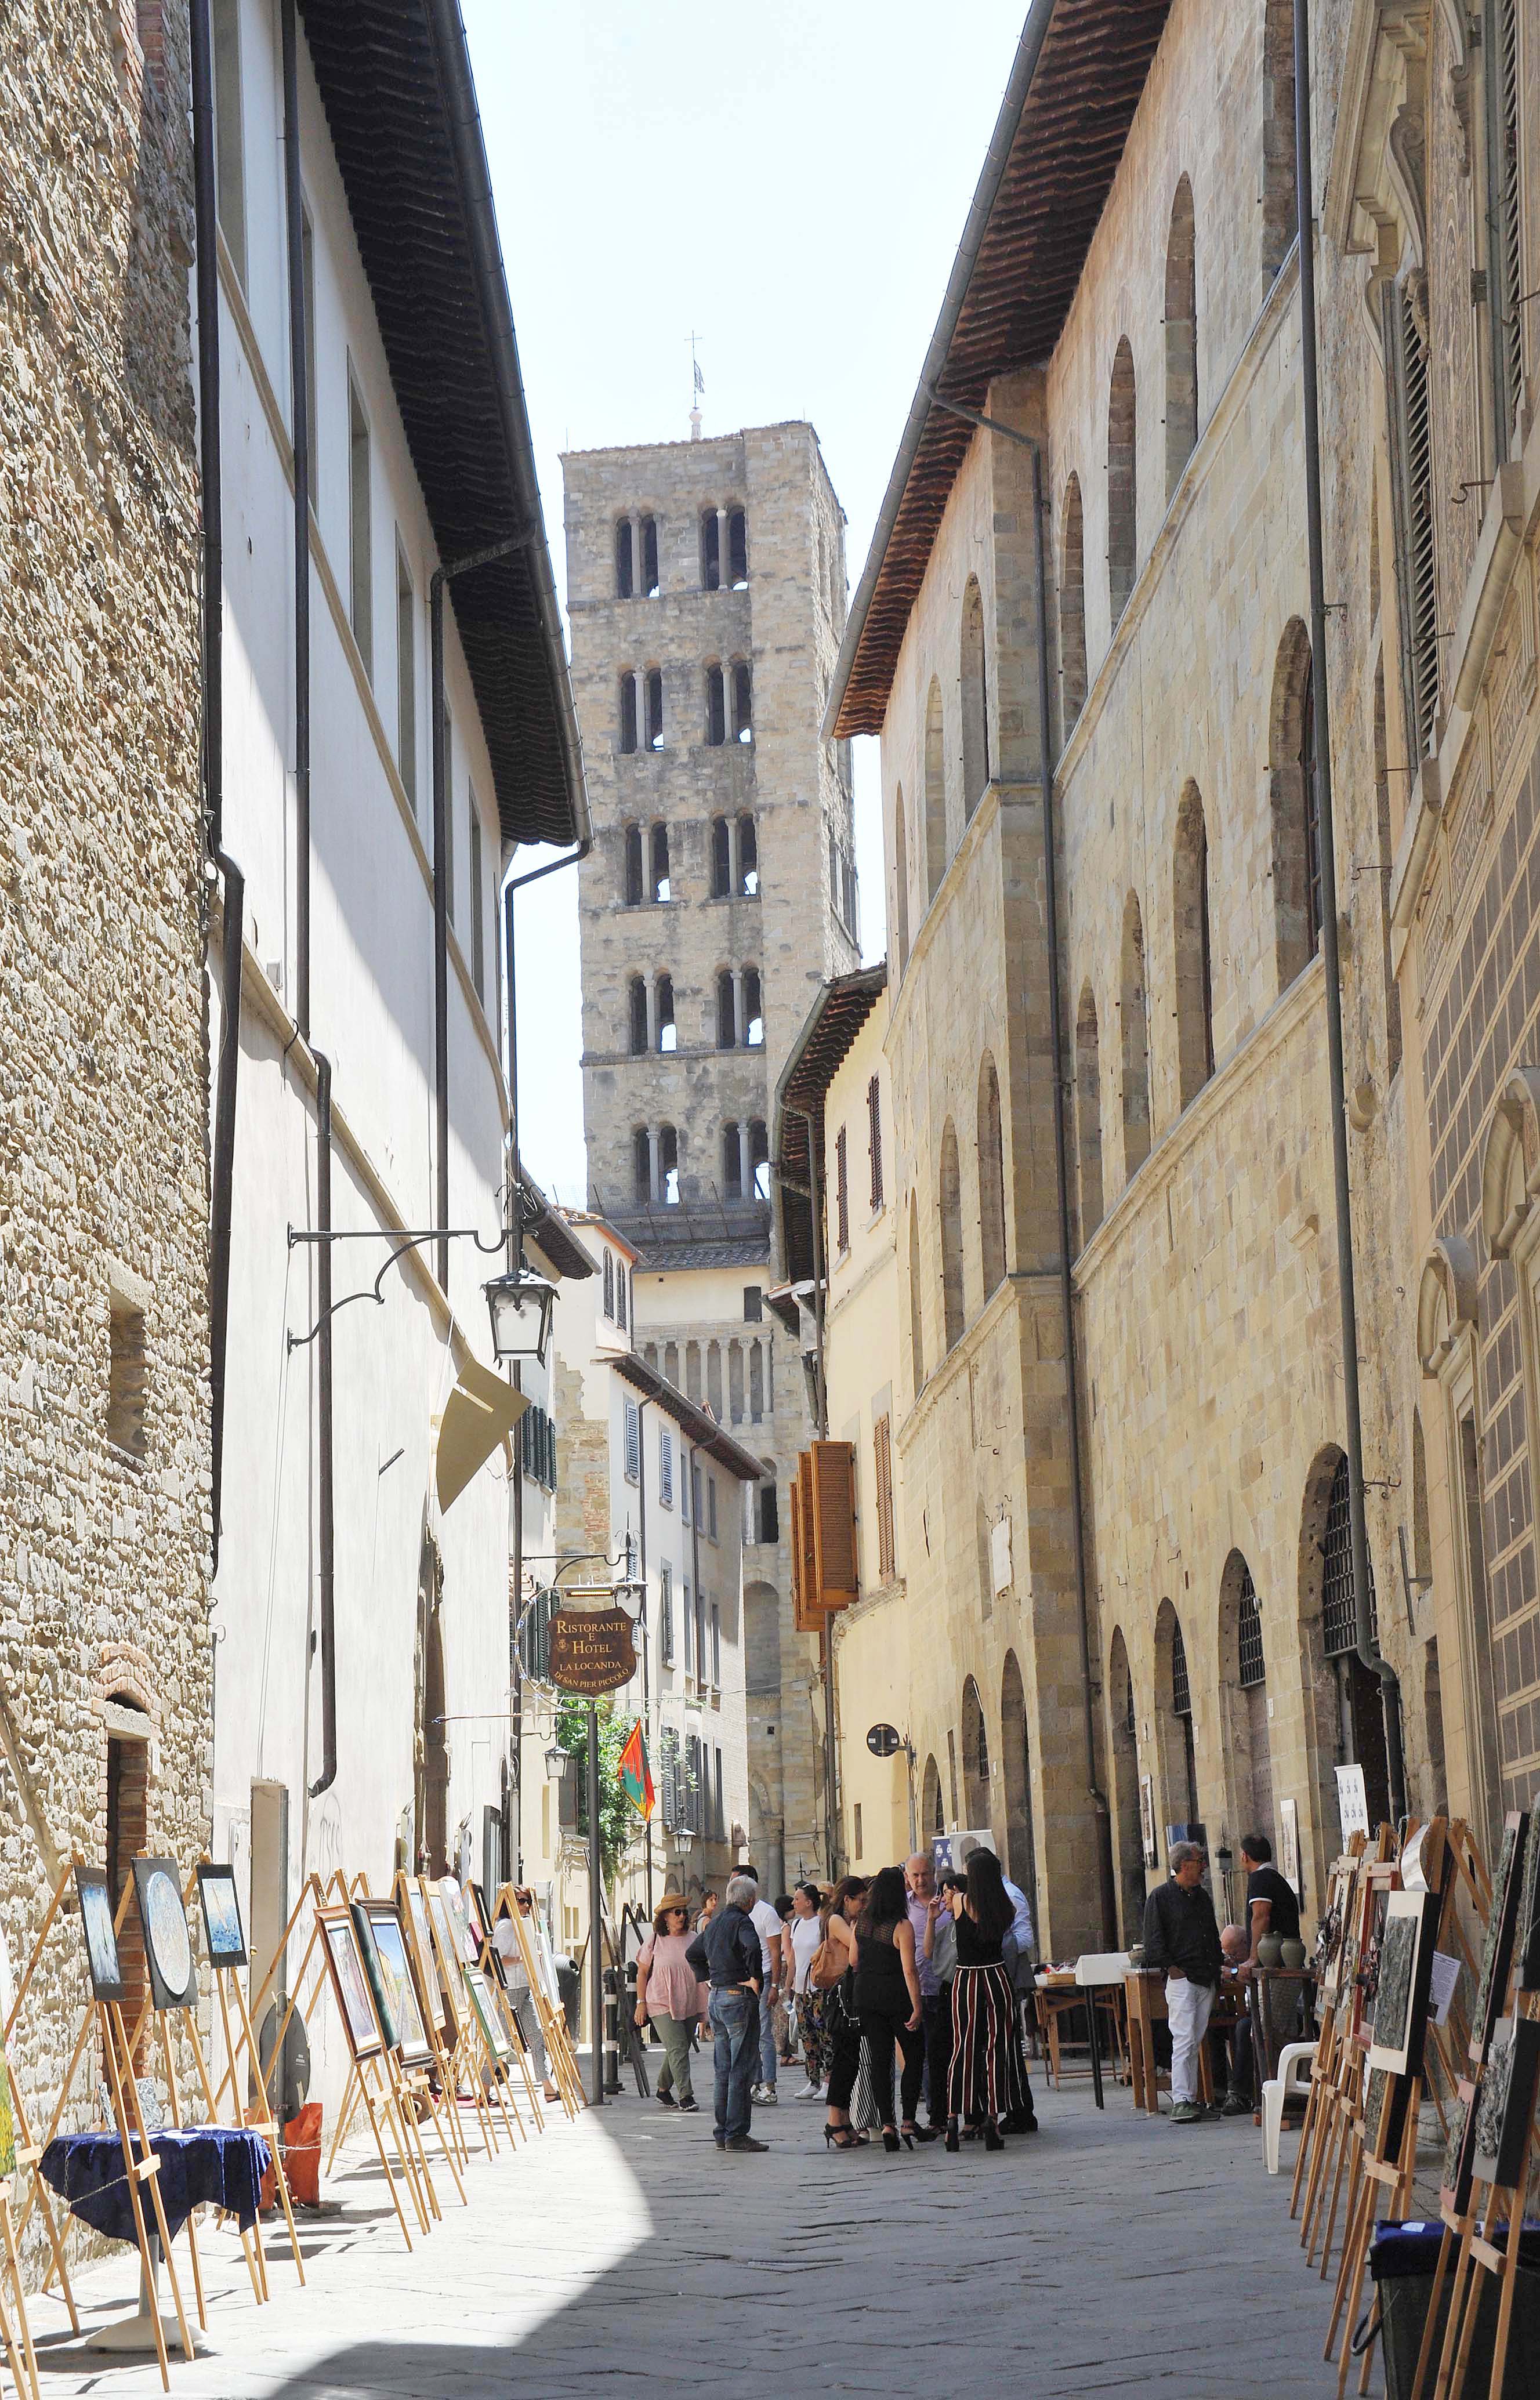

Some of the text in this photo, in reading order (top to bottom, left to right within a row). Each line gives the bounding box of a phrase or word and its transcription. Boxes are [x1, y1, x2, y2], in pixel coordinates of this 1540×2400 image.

[556, 1620, 626, 1634] RISTORANTE
[589, 1633, 595, 1641] E
[571, 1640, 613, 1654] HOTEL
[574, 1661, 622, 1670] LOCANDA
[554, 1671, 562, 1680] DI
[563, 1676, 579, 1687] SAN
[599, 1668, 629, 1687] PICCOLO
